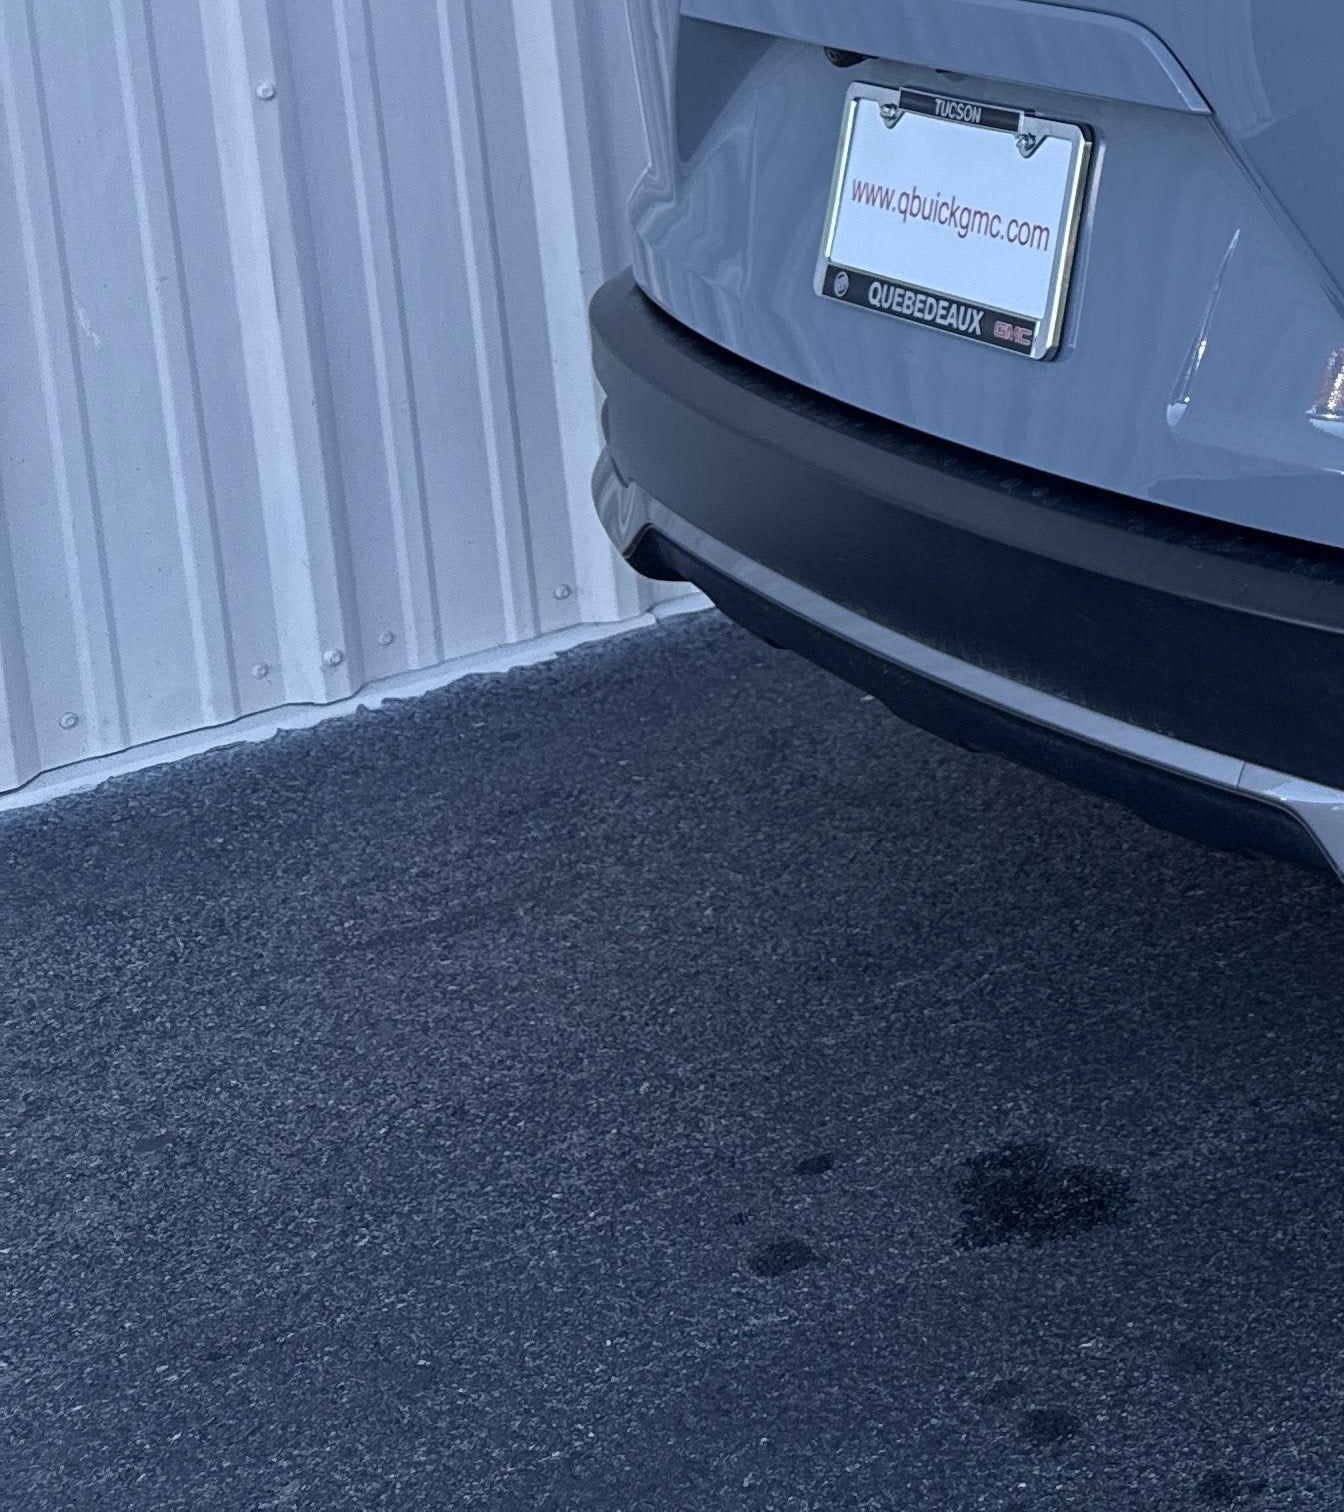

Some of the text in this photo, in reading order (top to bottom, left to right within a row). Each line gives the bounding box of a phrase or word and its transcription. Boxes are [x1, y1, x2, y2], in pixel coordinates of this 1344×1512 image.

[935, 98, 982, 124] TUCSON
[851, 178, 1050, 252] www.qbuickgmc.com
[868, 281, 1033, 346] QUEBEDEAUX GMC
